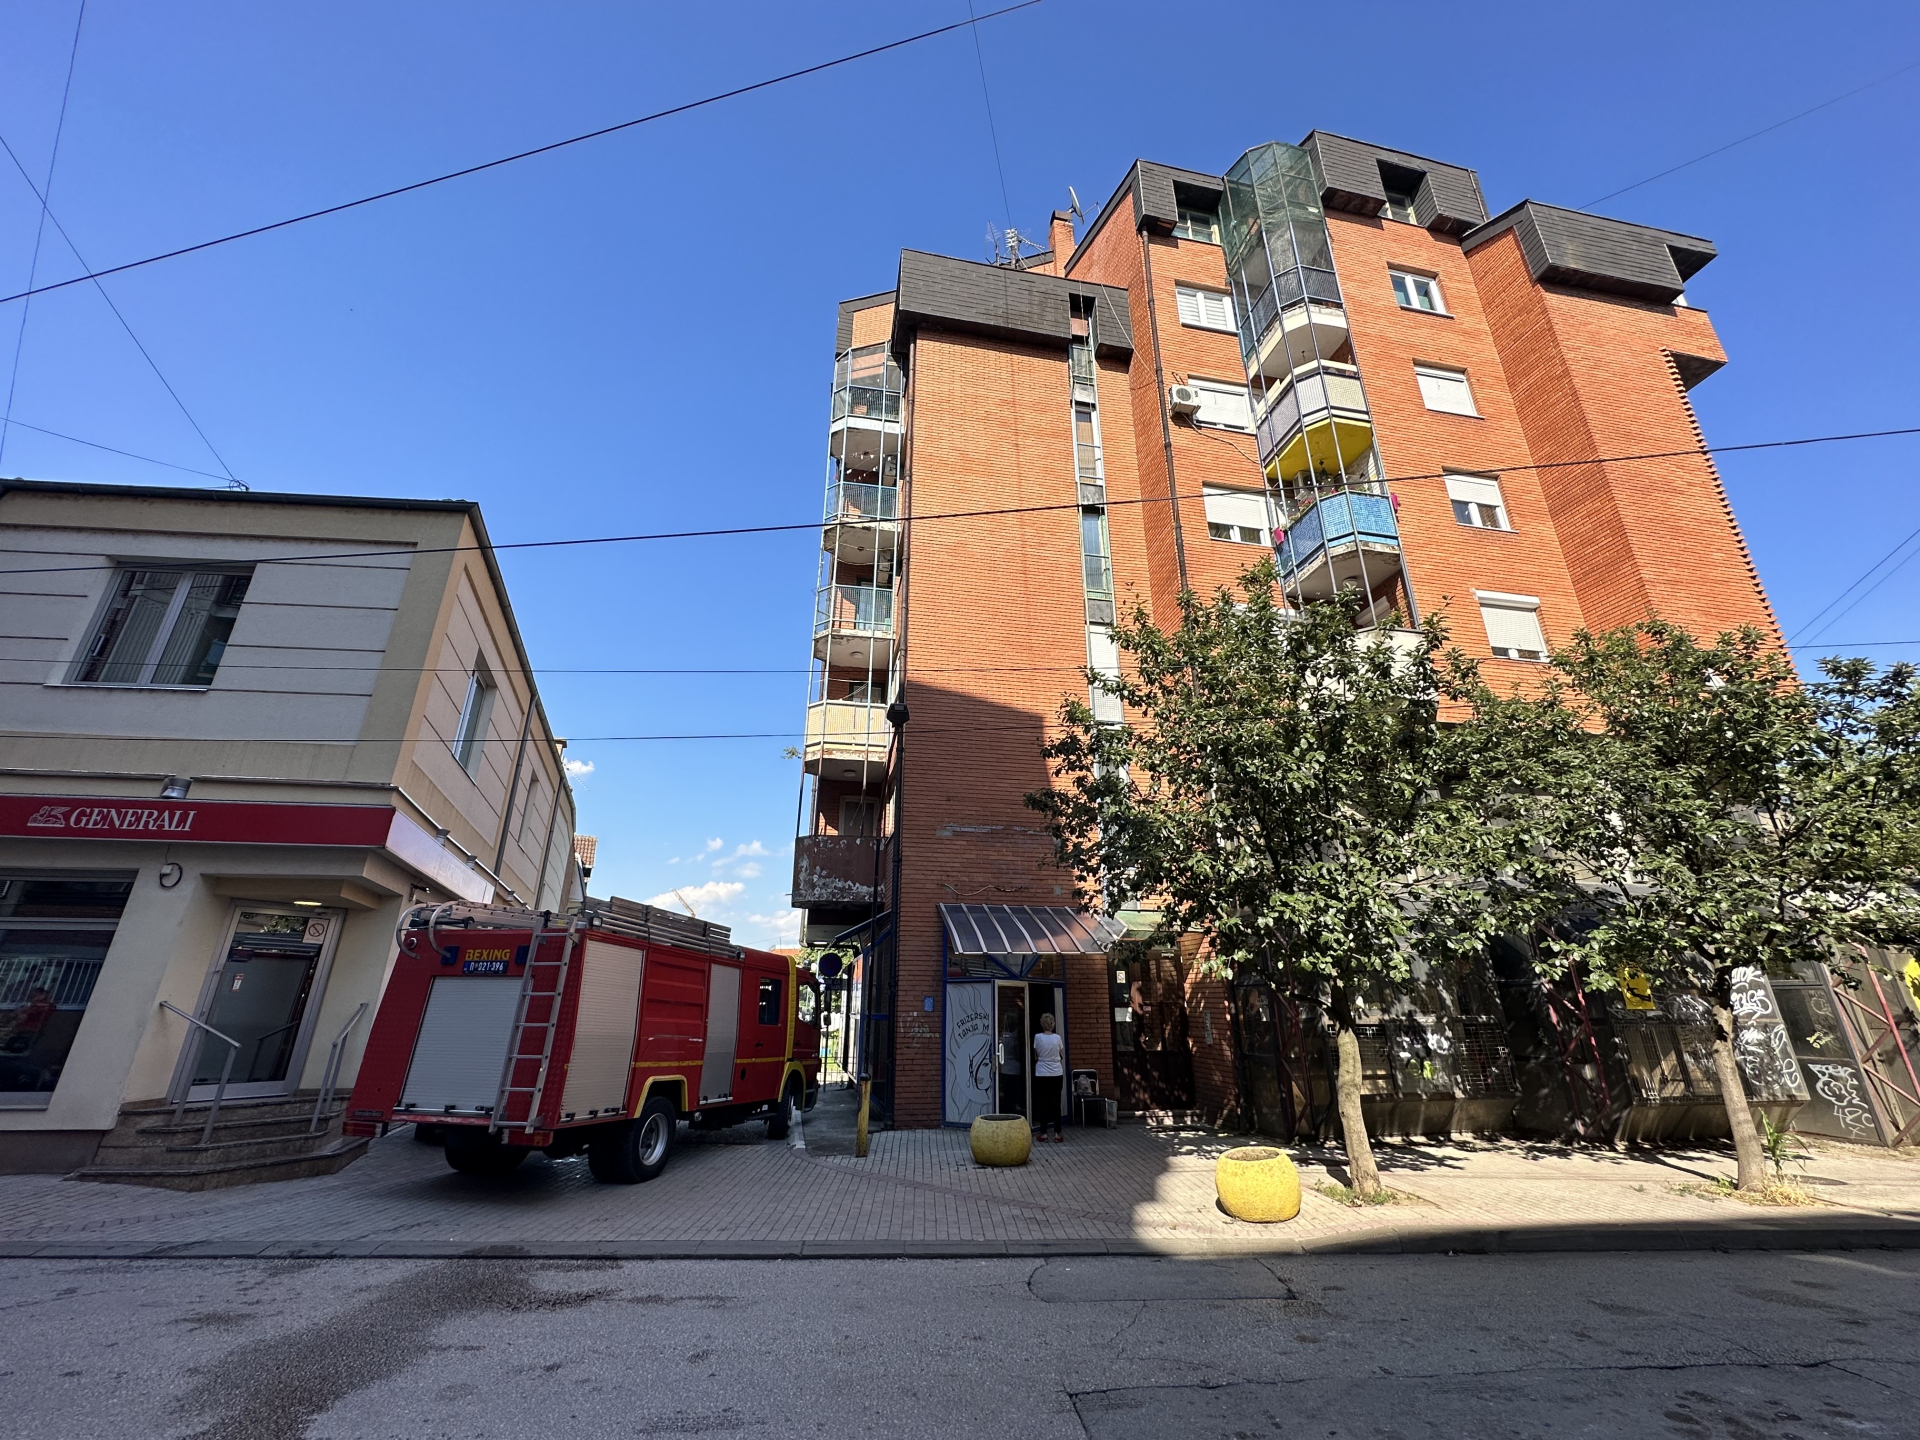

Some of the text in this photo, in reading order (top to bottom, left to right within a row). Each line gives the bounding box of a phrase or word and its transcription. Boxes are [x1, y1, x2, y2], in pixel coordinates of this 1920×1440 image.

[70, 807, 197, 831] GENERALI
[465, 949, 510, 960] BEXING
[958, 1023, 979, 1039] TANJA
